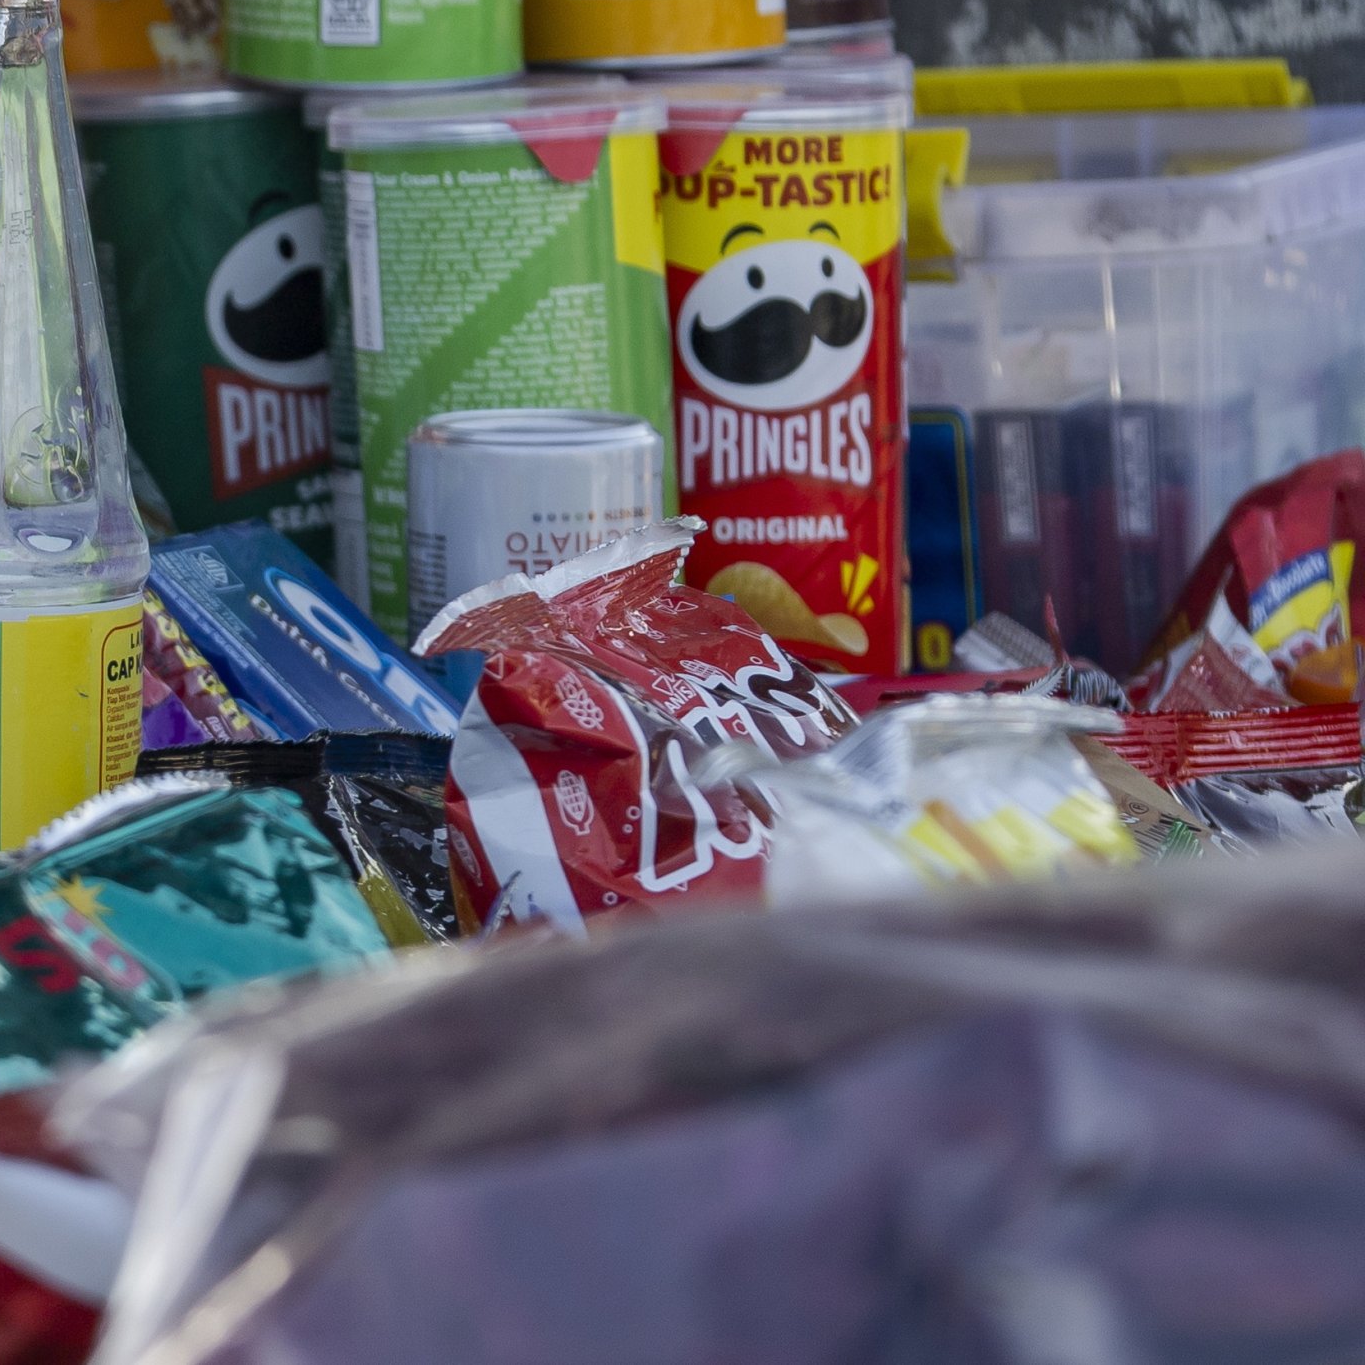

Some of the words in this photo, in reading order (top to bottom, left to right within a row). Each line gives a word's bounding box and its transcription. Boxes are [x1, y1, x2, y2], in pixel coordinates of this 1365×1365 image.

[743, 135, 845, 165] MORE
[400, 172, 440, 185] Cream
[219, 382, 329, 483] PRIN
[677, 392, 873, 492] PRINGLES
[711, 513, 850, 545] ORIGINAL
[249, 594, 329, 671] Dutch
[107, 655, 135, 682] CAP
